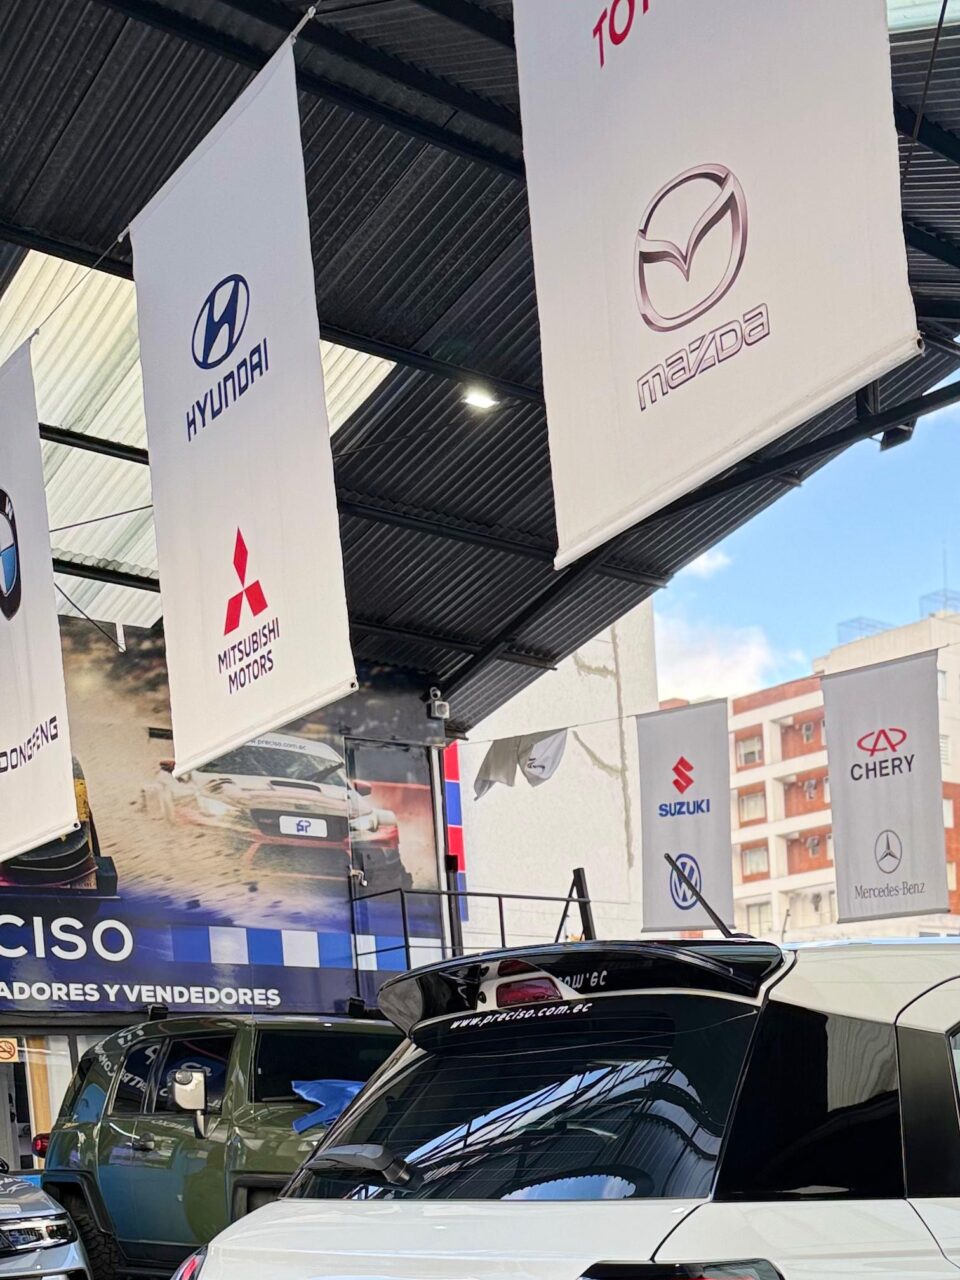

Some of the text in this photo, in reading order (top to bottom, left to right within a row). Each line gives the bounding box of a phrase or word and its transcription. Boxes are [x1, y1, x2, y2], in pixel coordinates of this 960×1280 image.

[593, 0, 649, 68] TO
[186, 337, 269, 442] HYUNDAI
[217, 617, 280, 674] MITSUBISHI
[228, 648, 274, 694] MOTORS
[850, 754, 915, 781] CHERY
[658, 798, 711, 818] SUZUKI
[854, 881, 926, 900] Mercedes-Benz
[102, 984, 119, 1002] Y
[123, 986, 281, 1006] VENDEDORES
[450, 1002, 593, 1029] www.preciso.com.ec
